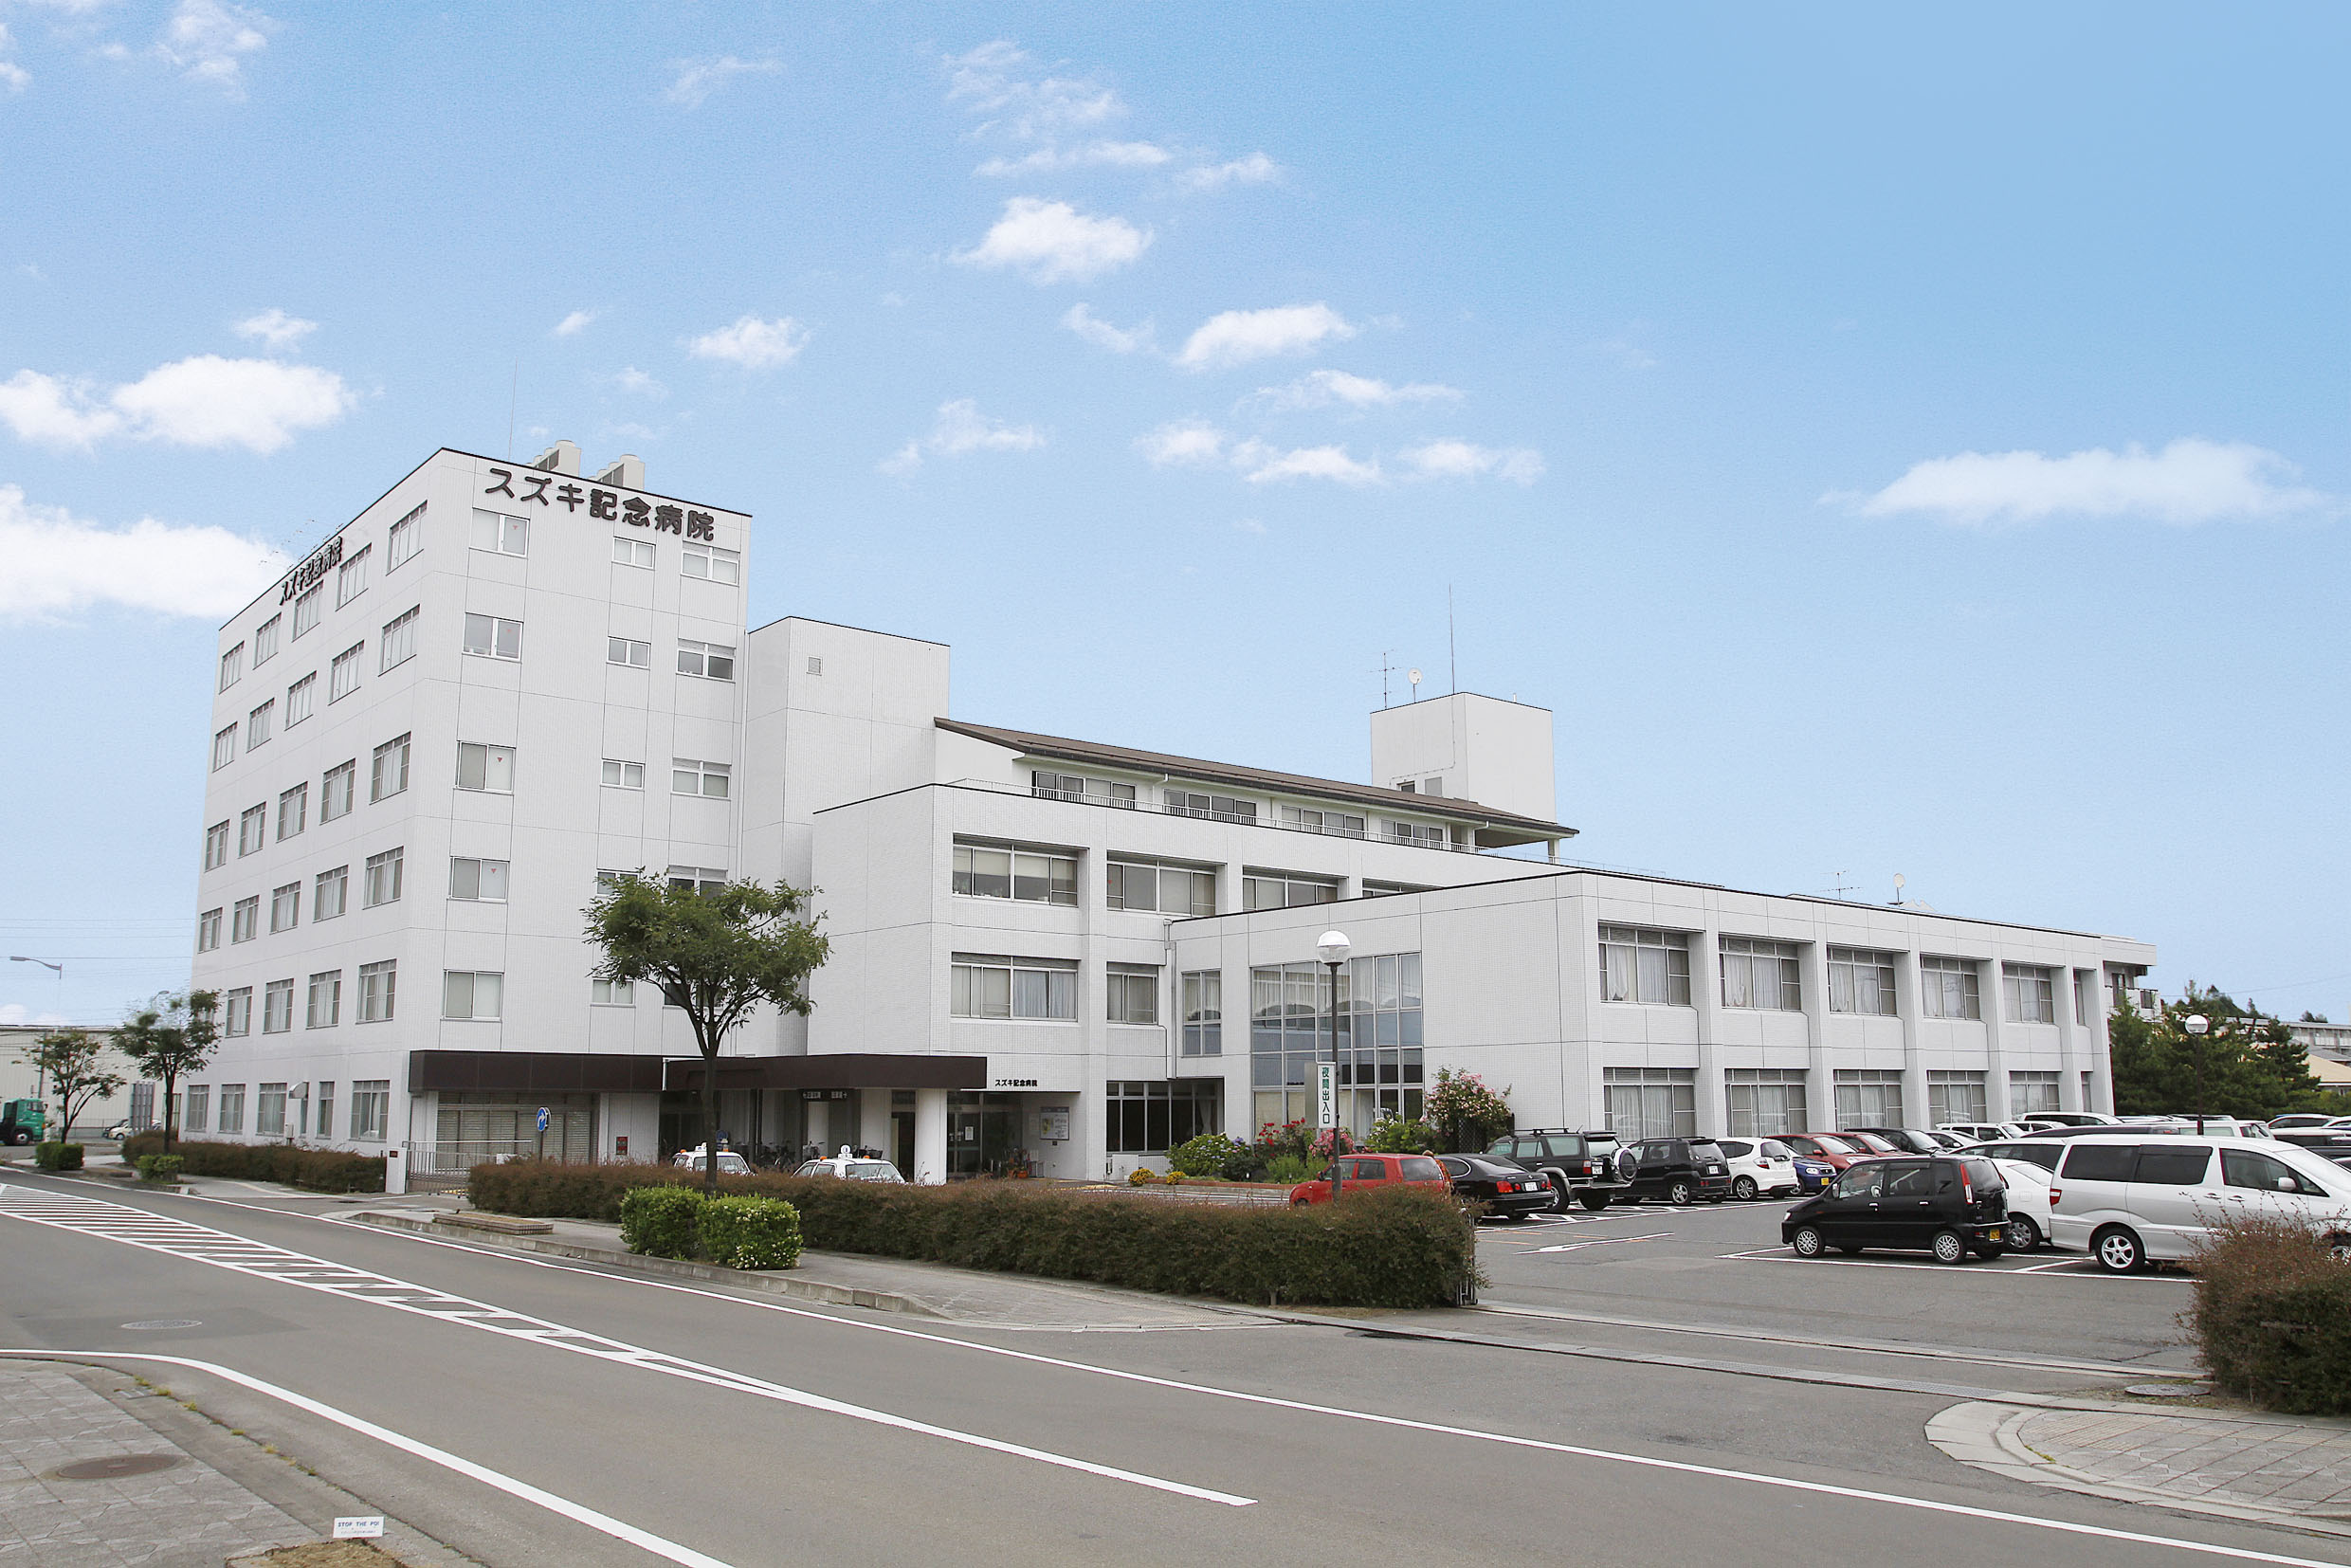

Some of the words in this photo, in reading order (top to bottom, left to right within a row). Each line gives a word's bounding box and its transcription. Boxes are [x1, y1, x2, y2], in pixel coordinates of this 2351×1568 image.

[485, 467, 714, 541] スズキ記念病院
[994, 1079, 1038, 1087] スズキ記念病院
[1321, 1067, 1331, 1124] 夜間出入口
